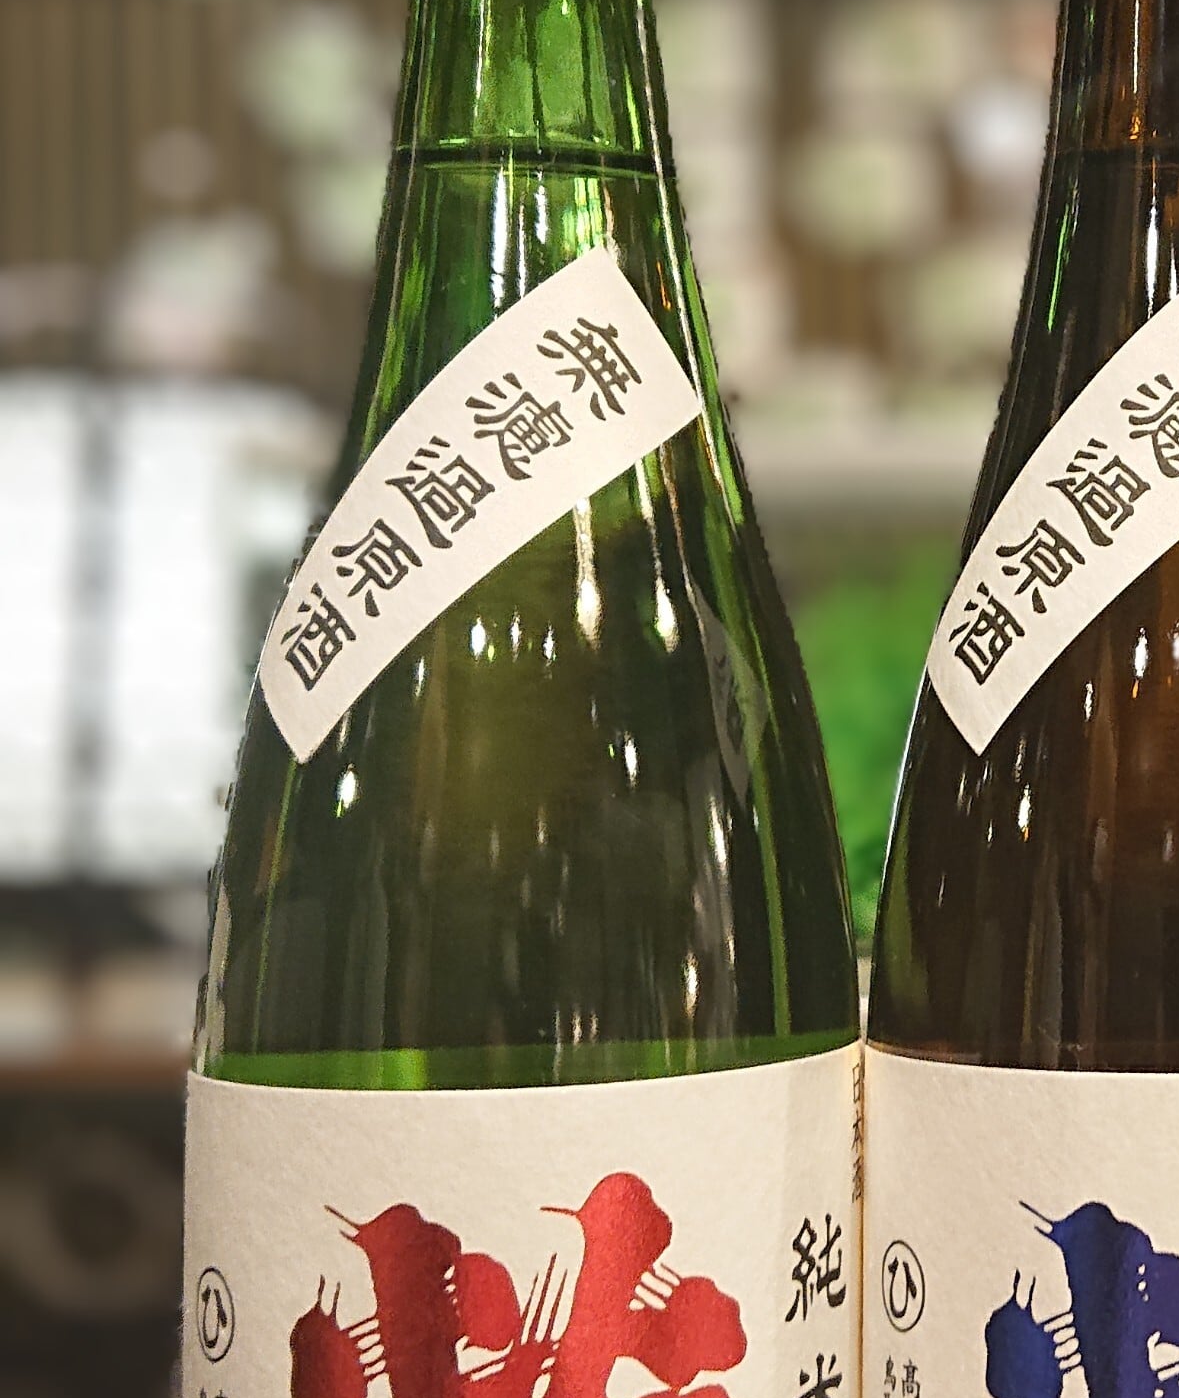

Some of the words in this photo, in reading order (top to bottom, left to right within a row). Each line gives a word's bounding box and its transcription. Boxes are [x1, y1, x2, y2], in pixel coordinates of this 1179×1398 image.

[280, 316, 642, 691] 無濾過原酒
